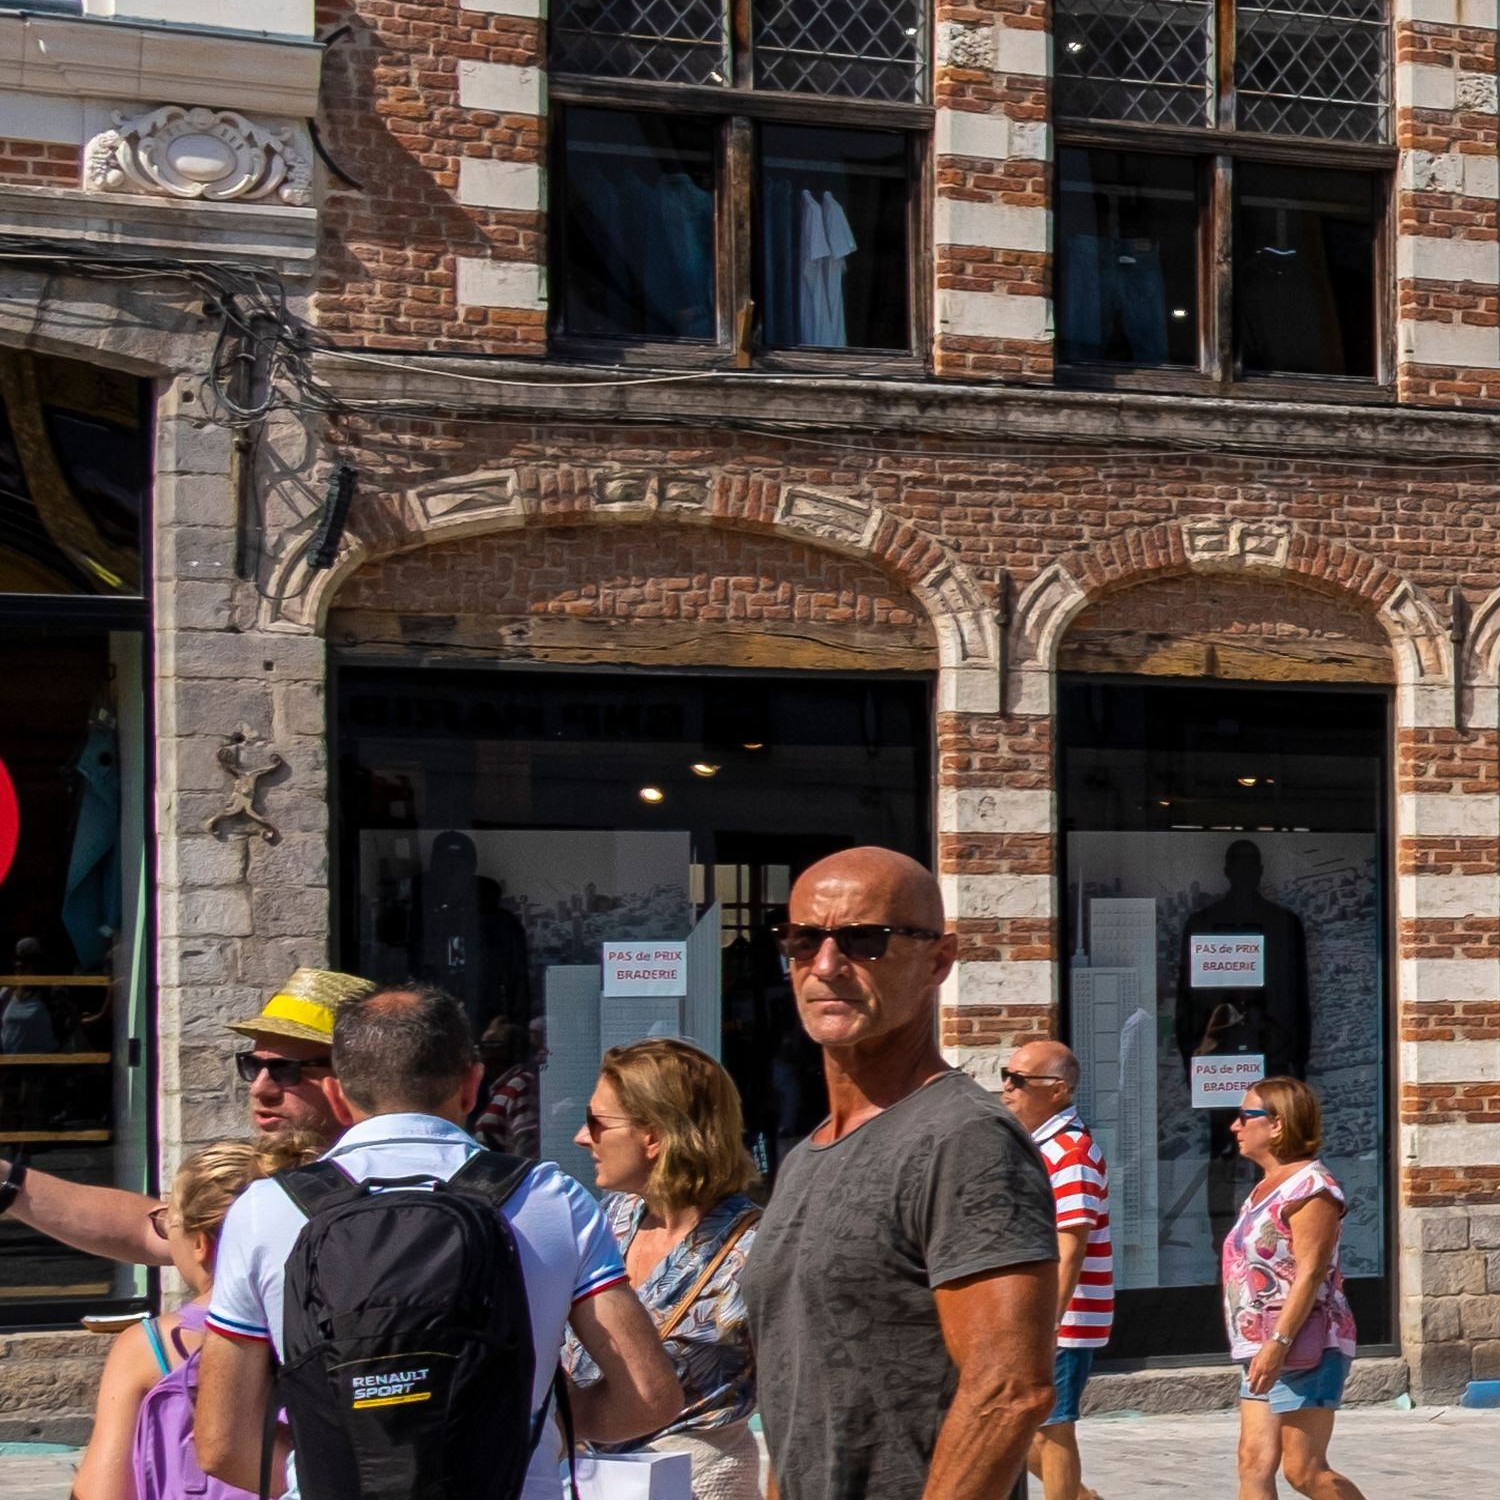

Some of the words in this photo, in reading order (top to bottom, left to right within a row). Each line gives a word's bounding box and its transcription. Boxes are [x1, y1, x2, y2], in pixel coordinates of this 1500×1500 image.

[1195, 944, 1217, 954] PAS
[1219, 944, 1233, 954] de
[1236, 944, 1260, 954] PRIX
[608, 951, 632, 961] PAS
[635, 951, 651, 961] de
[654, 951, 682, 961] PRIX
[1202, 961, 1256, 971] BRADERIE
[616, 969, 678, 980] BRADERIE
[1196, 1064, 1217, 1074] PAS
[1220, 1064, 1234, 1074] de
[1236, 1063, 1261, 1073] PRIX
[1203, 1081, 1253, 1092] BRADER
[352, 1368, 430, 1388] RENAULT
[354, 1382, 415, 1400] SPORT
